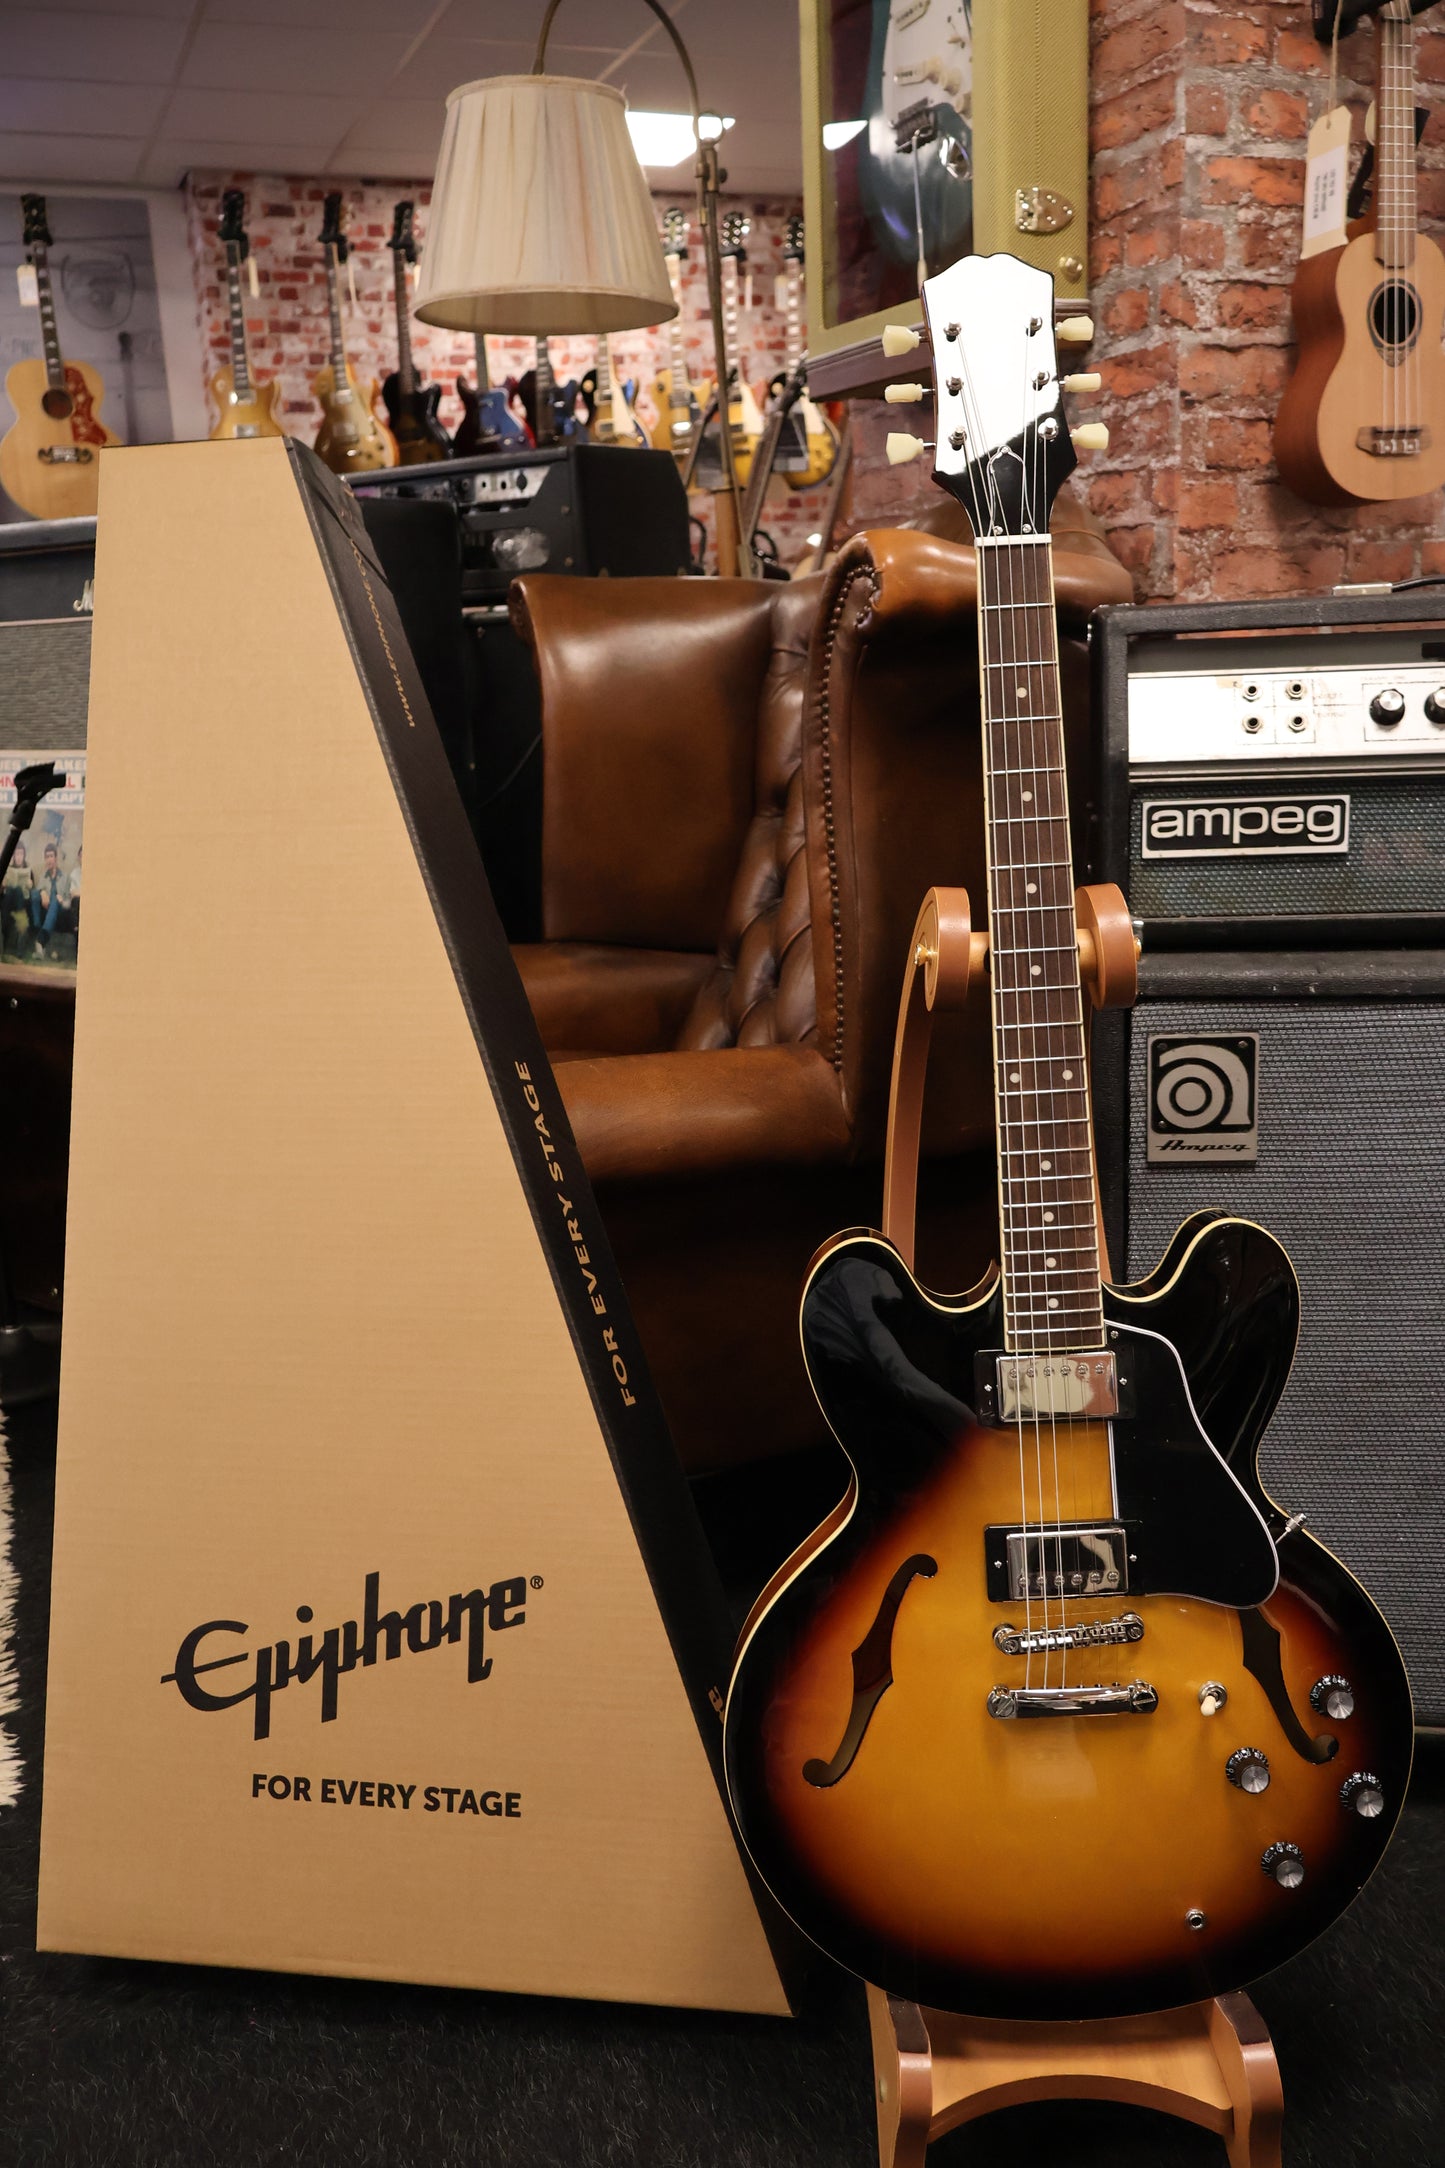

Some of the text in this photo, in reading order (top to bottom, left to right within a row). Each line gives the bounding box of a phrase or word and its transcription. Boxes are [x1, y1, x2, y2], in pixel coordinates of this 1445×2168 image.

[1149, 803, 1342, 844] ampeg
[1156, 1139, 1251, 1153] Ampeg
[514, 1060, 637, 1407] FOR EVERY STAGE
[251, 1773, 522, 1818] FOR EVERY STAGE
